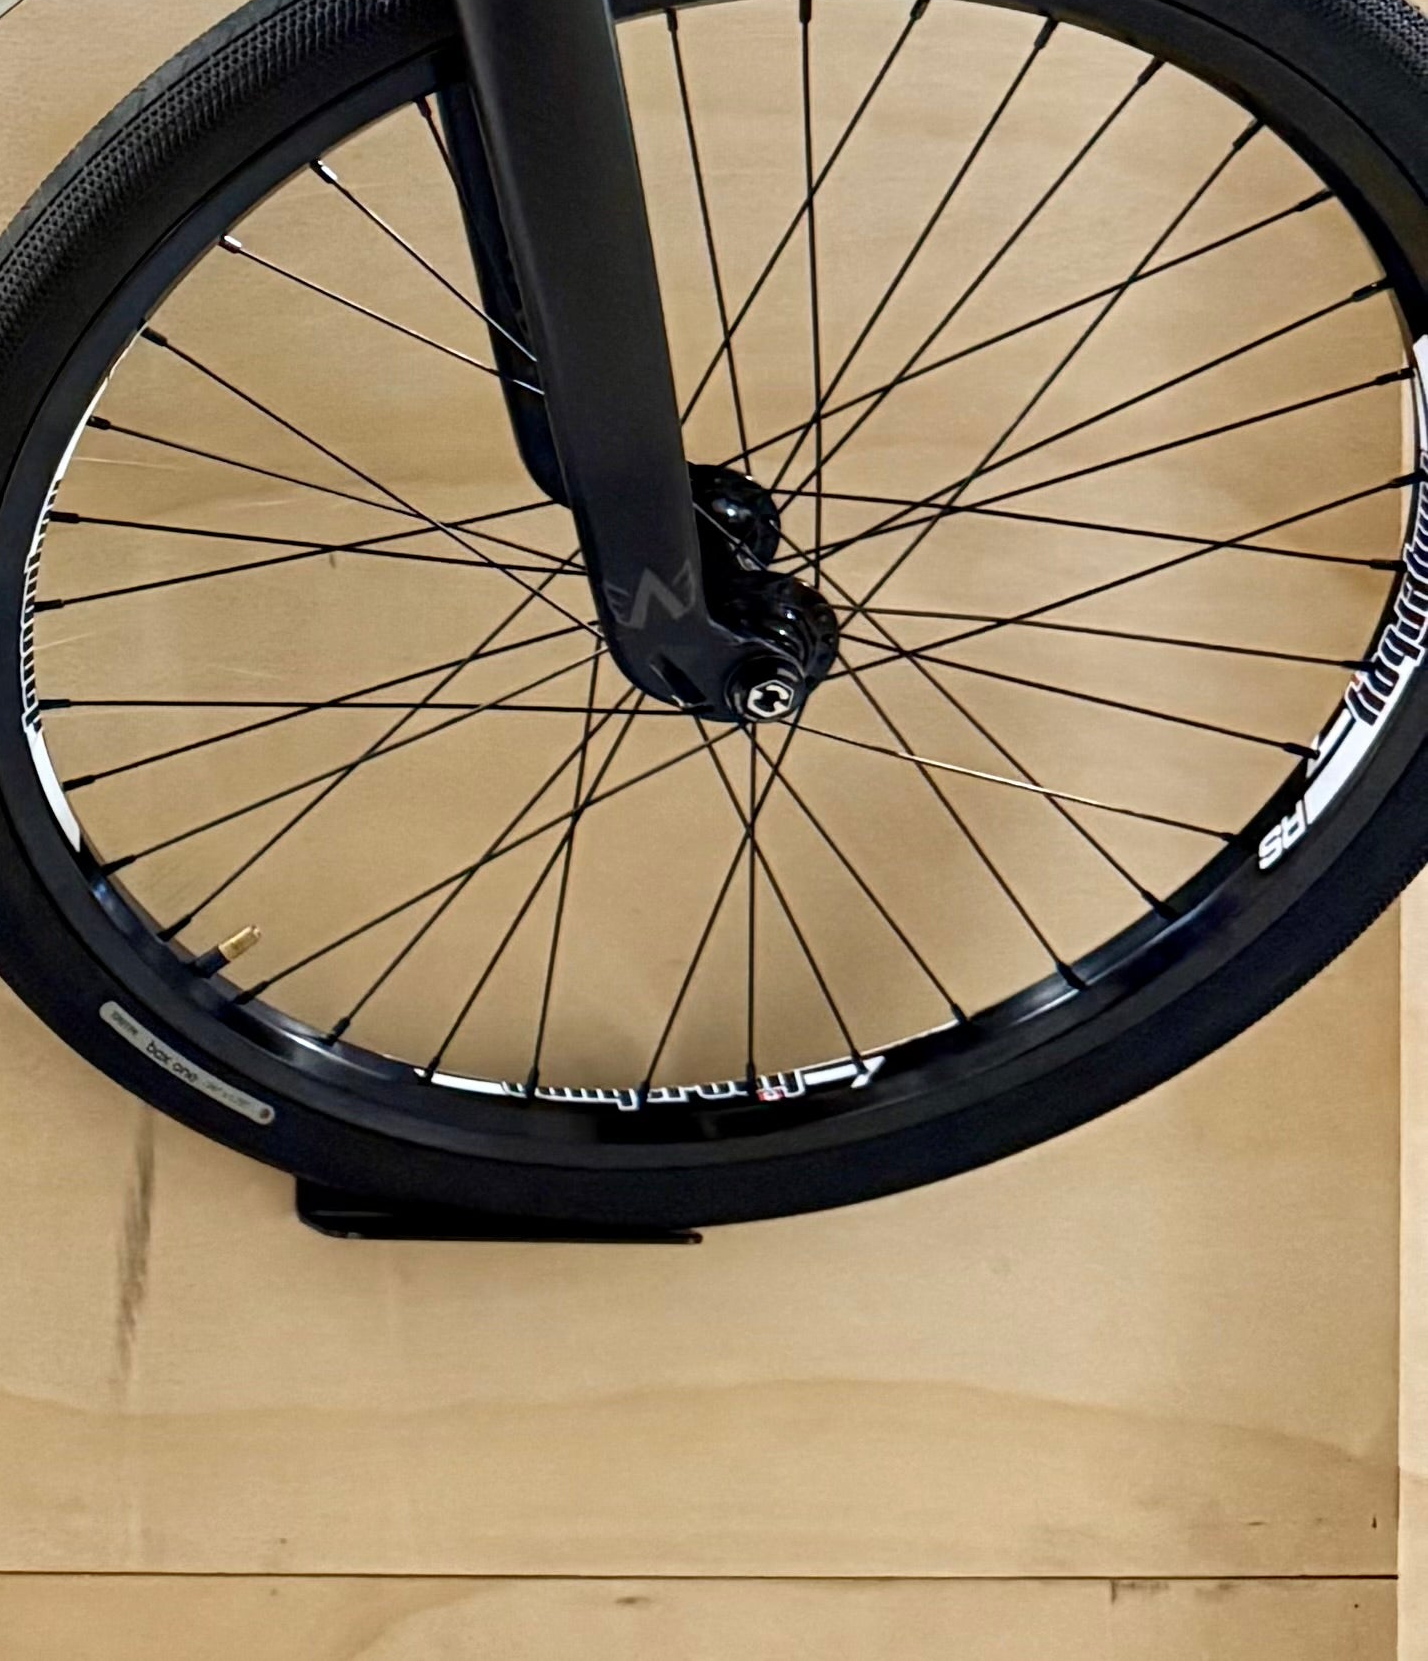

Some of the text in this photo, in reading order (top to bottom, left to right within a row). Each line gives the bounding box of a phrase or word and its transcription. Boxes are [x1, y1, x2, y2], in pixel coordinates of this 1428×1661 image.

[1258, 799, 1306, 870] RS
[146, 1040, 198, 1084] box one
